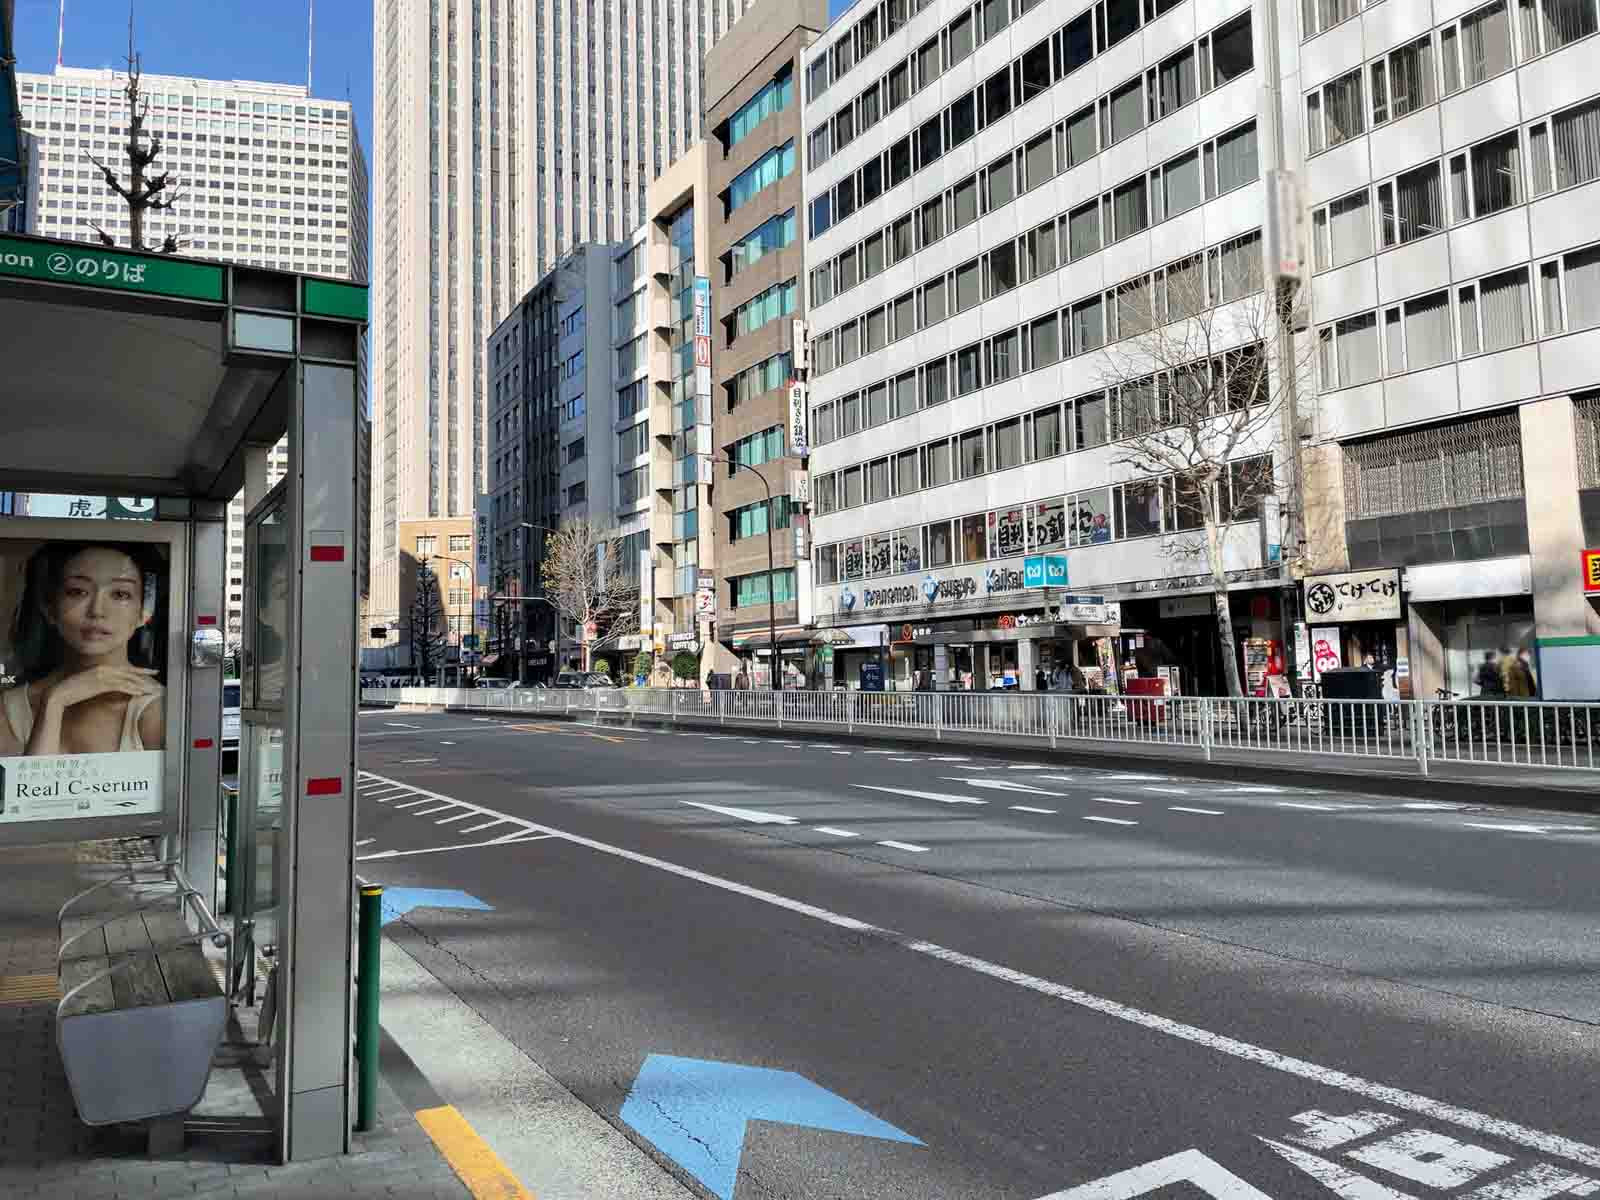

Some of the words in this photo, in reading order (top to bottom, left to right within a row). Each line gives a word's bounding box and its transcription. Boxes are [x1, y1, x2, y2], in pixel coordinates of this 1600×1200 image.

[1334, 578, 1397, 600] てけてけ
[16, 780, 60, 798] Real
[67, 779, 149, 795] C-serum
